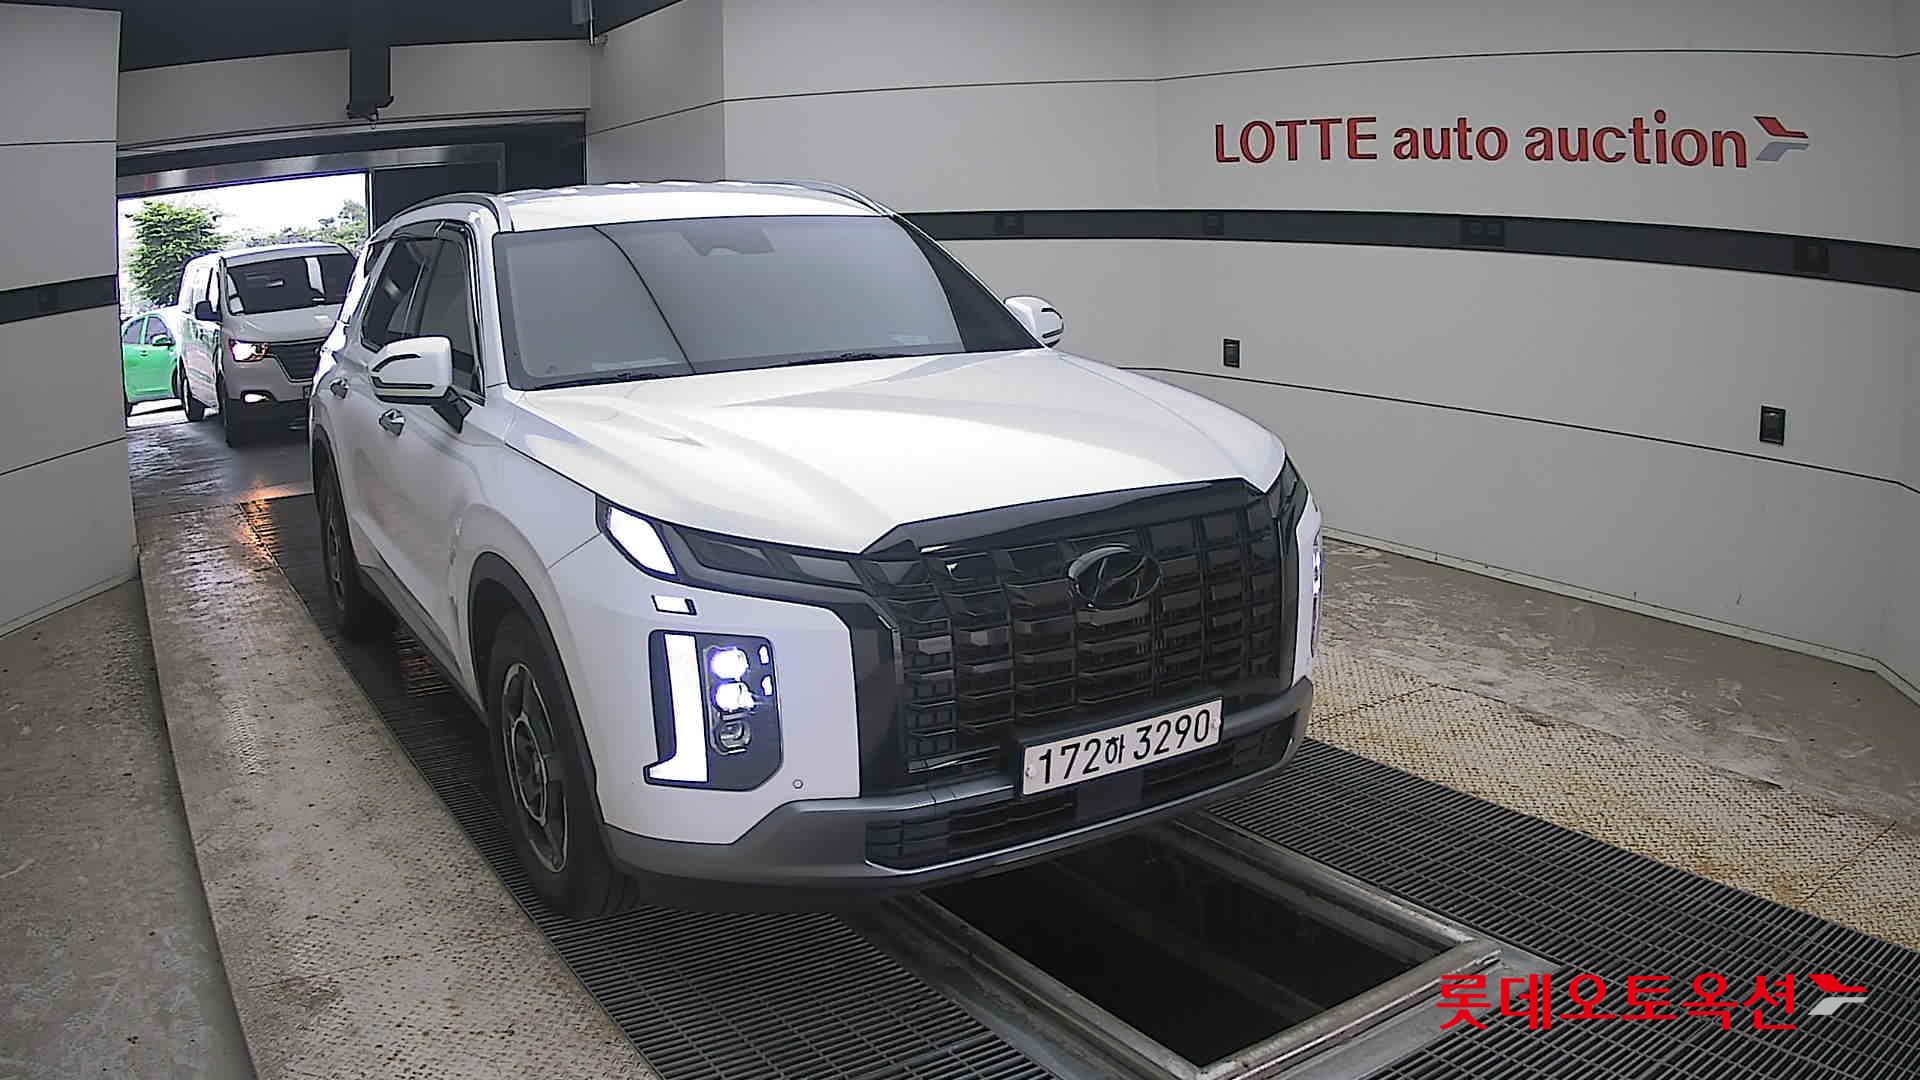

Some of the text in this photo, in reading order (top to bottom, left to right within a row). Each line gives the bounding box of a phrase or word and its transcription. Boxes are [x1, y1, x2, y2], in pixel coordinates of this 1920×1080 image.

[1215, 110, 1748, 168] LOTTE auto auction
[1039, 709, 1210, 784] 172하 3290
